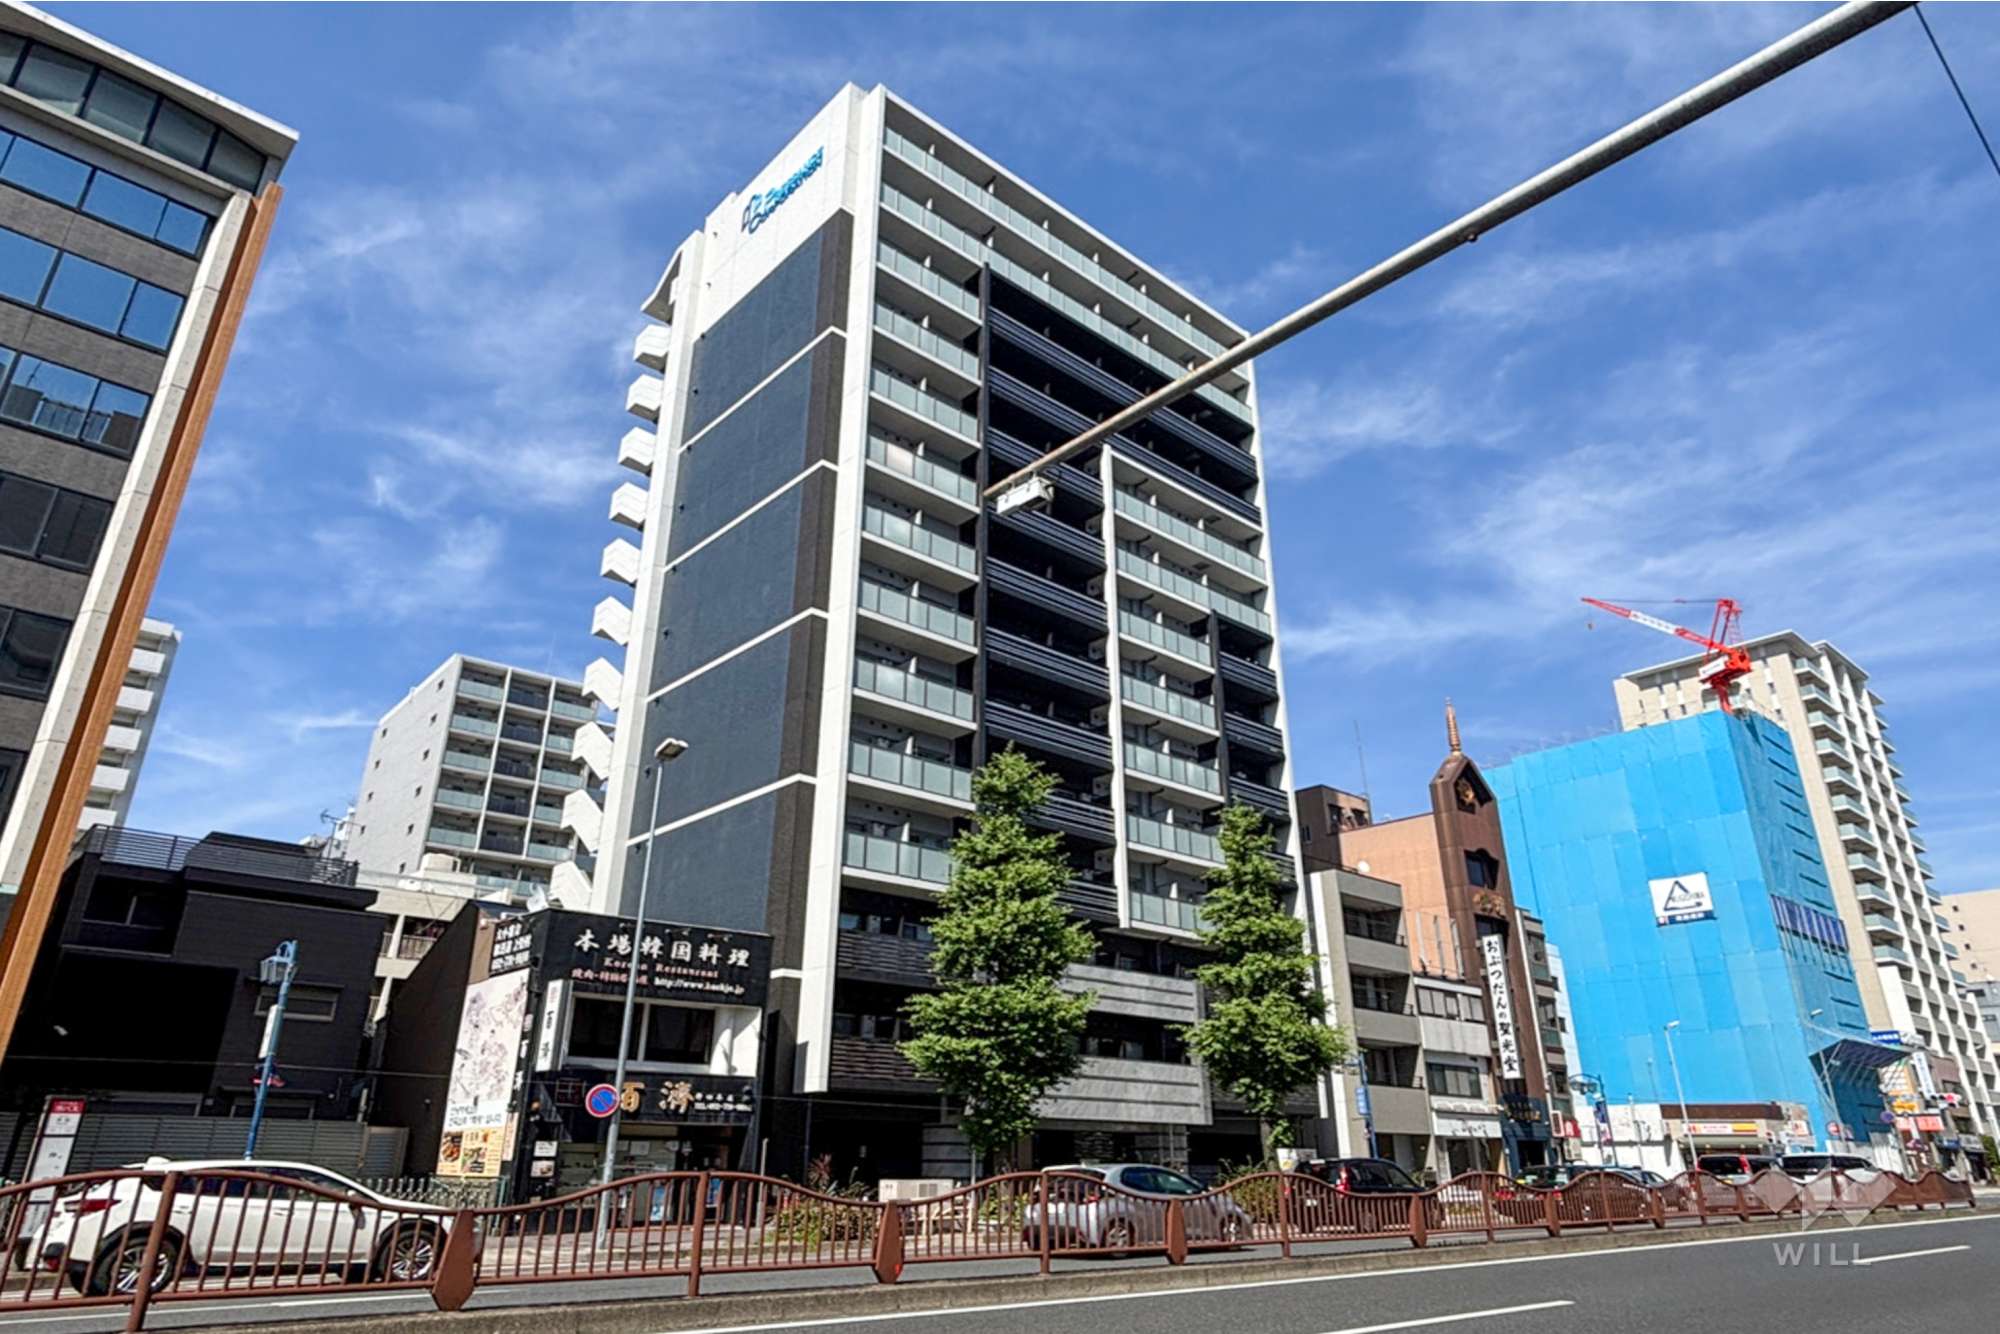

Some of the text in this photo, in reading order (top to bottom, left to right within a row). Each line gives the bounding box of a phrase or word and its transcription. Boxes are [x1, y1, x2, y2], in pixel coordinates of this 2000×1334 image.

[574, 929, 750, 967] 本場韓国料理
[604, 957, 648, 971] Koren
